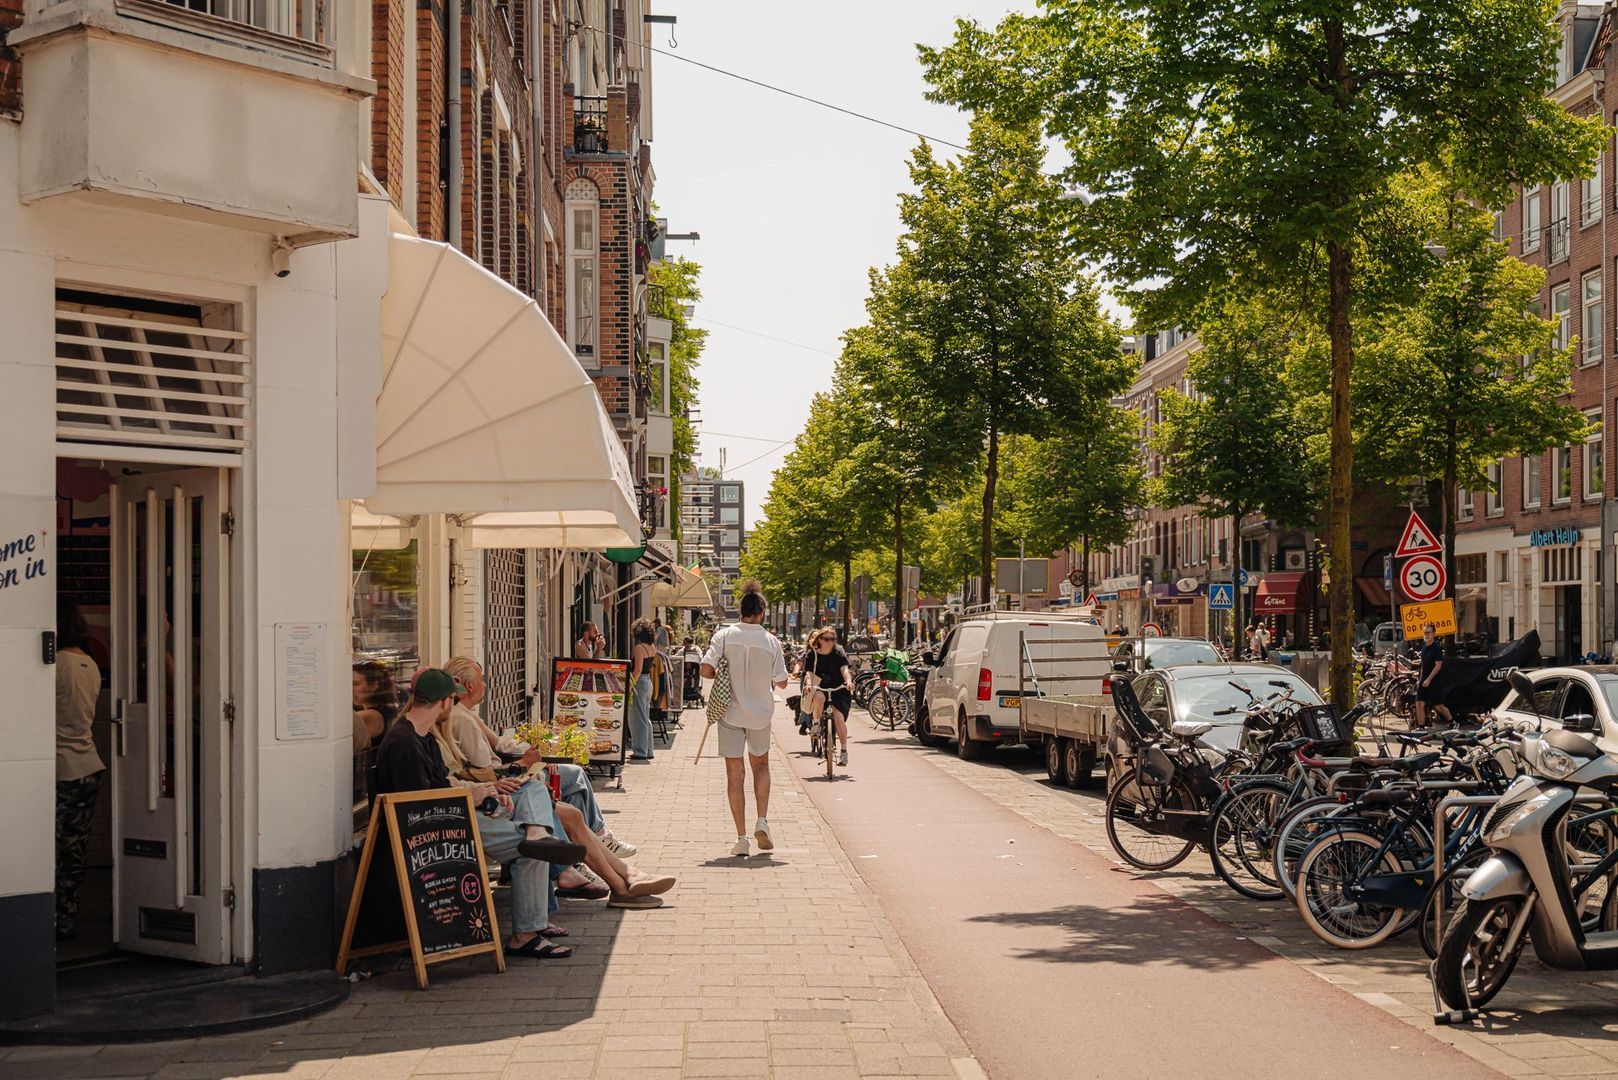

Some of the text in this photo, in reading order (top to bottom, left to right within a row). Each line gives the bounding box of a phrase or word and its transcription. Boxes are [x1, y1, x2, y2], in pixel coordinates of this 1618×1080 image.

[1530, 526, 1578, 546] Albert Heijn
[0, 534, 36, 562] me
[25, 556, 47, 580] in
[1409, 568, 1438, 589] 30
[1406, 624, 1417, 632] op
[407, 829, 466, 850] WEEKDAY LUNCH
[411, 839, 477, 871] MEAL DEAL!
